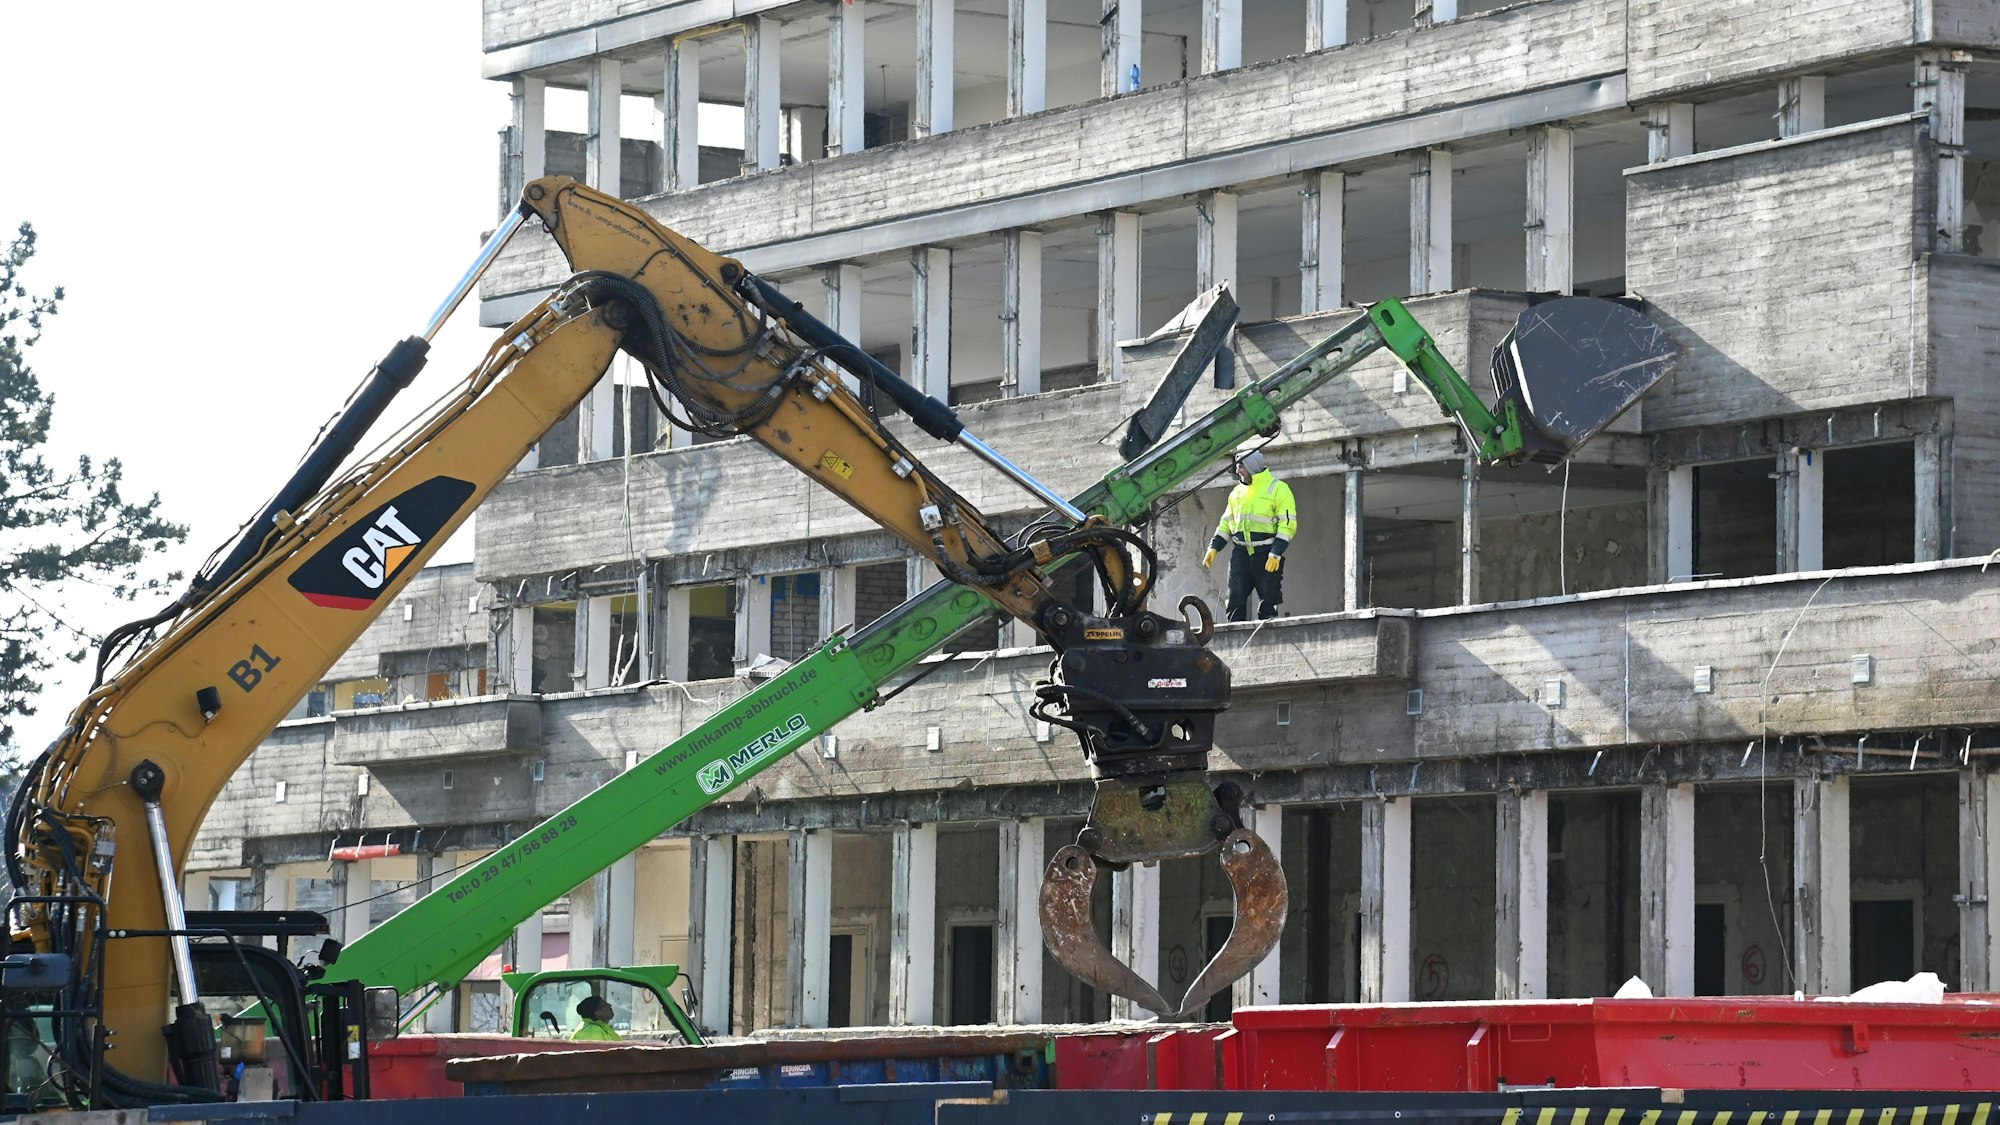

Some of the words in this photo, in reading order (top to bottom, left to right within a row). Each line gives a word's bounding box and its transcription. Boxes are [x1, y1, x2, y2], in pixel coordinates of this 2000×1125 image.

[342, 505, 422, 588] CAT
[1086, 630, 1121, 638] ZEPPELIN
[226, 643, 282, 693] B1
[655, 667, 818, 776] www.linkamp-abbruch.de
[728, 714, 806, 769] MERLO
[481, 865, 499, 882] 29
[540, 827, 559, 845] 88
[559, 815, 578, 832] 28
